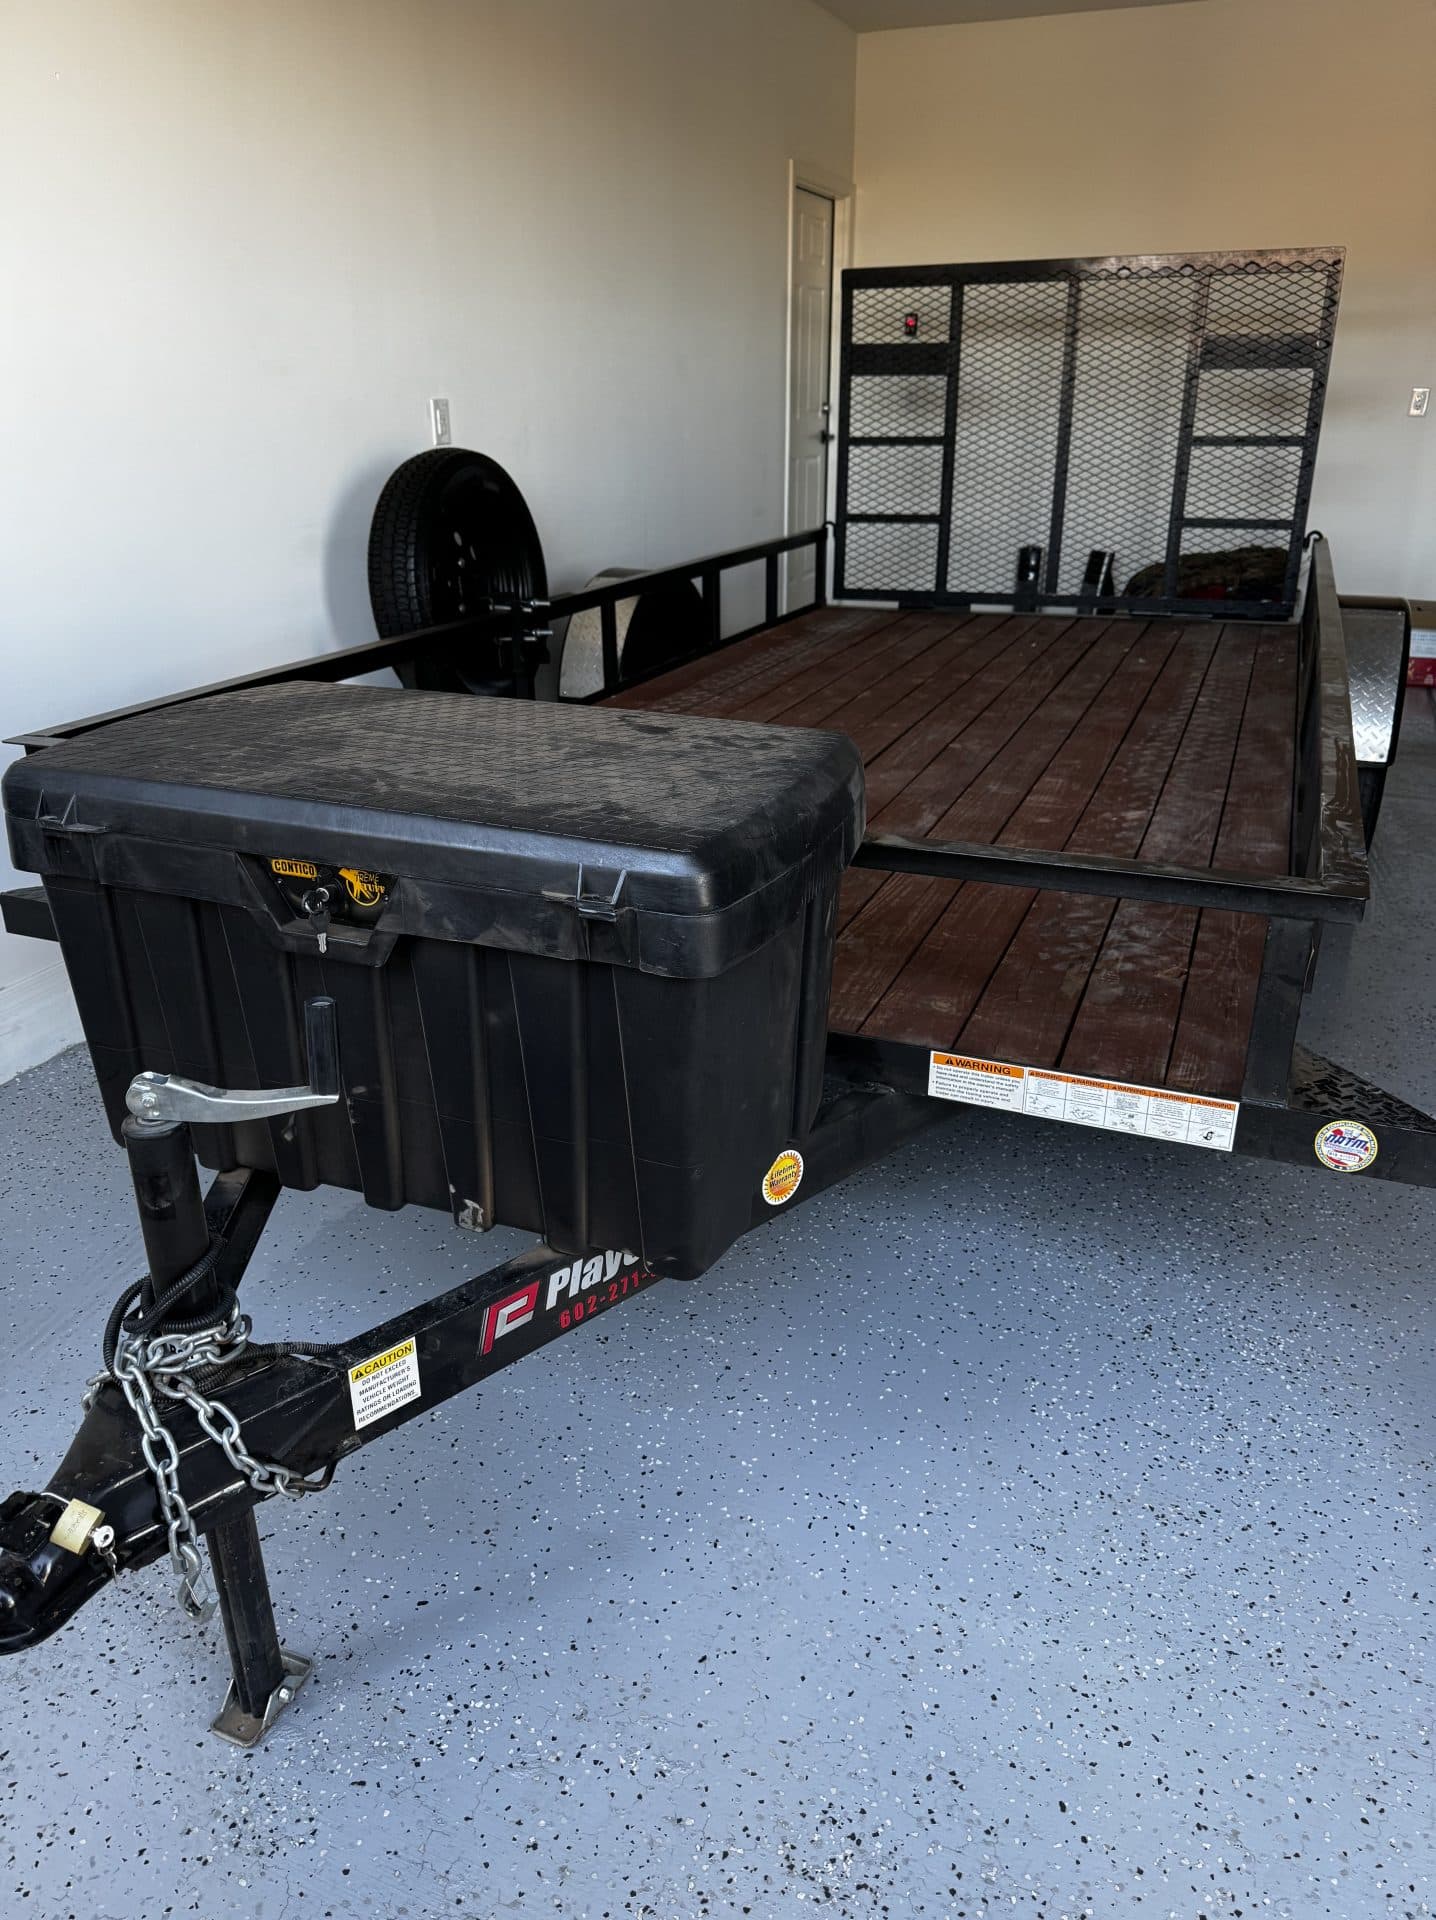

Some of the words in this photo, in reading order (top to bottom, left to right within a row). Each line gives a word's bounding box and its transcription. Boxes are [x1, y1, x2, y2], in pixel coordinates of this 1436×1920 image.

[274, 861, 315, 876] CONTICO
[955, 1058, 1011, 1075] WARNING
[770, 1171, 797, 1188] Warranty
[771, 1163, 797, 1179] Lifetime
[559, 1270, 656, 1329] 602-271-
[361, 1377, 371, 1386] DO
[371, 1371, 383, 1382] NOT
[384, 1359, 407, 1375] EXCEED
[364, 1344, 412, 1374] CAUTION
[358, 1366, 411, 1396] MANUFACTURER'S
[362, 1388, 387, 1403] VEHICLE
[387, 1375, 410, 1391] WEIGHT
[356, 1400, 382, 1416] RATINGS
[382, 1393, 392, 1402] OR
[392, 1380, 417, 1397] LOADING
